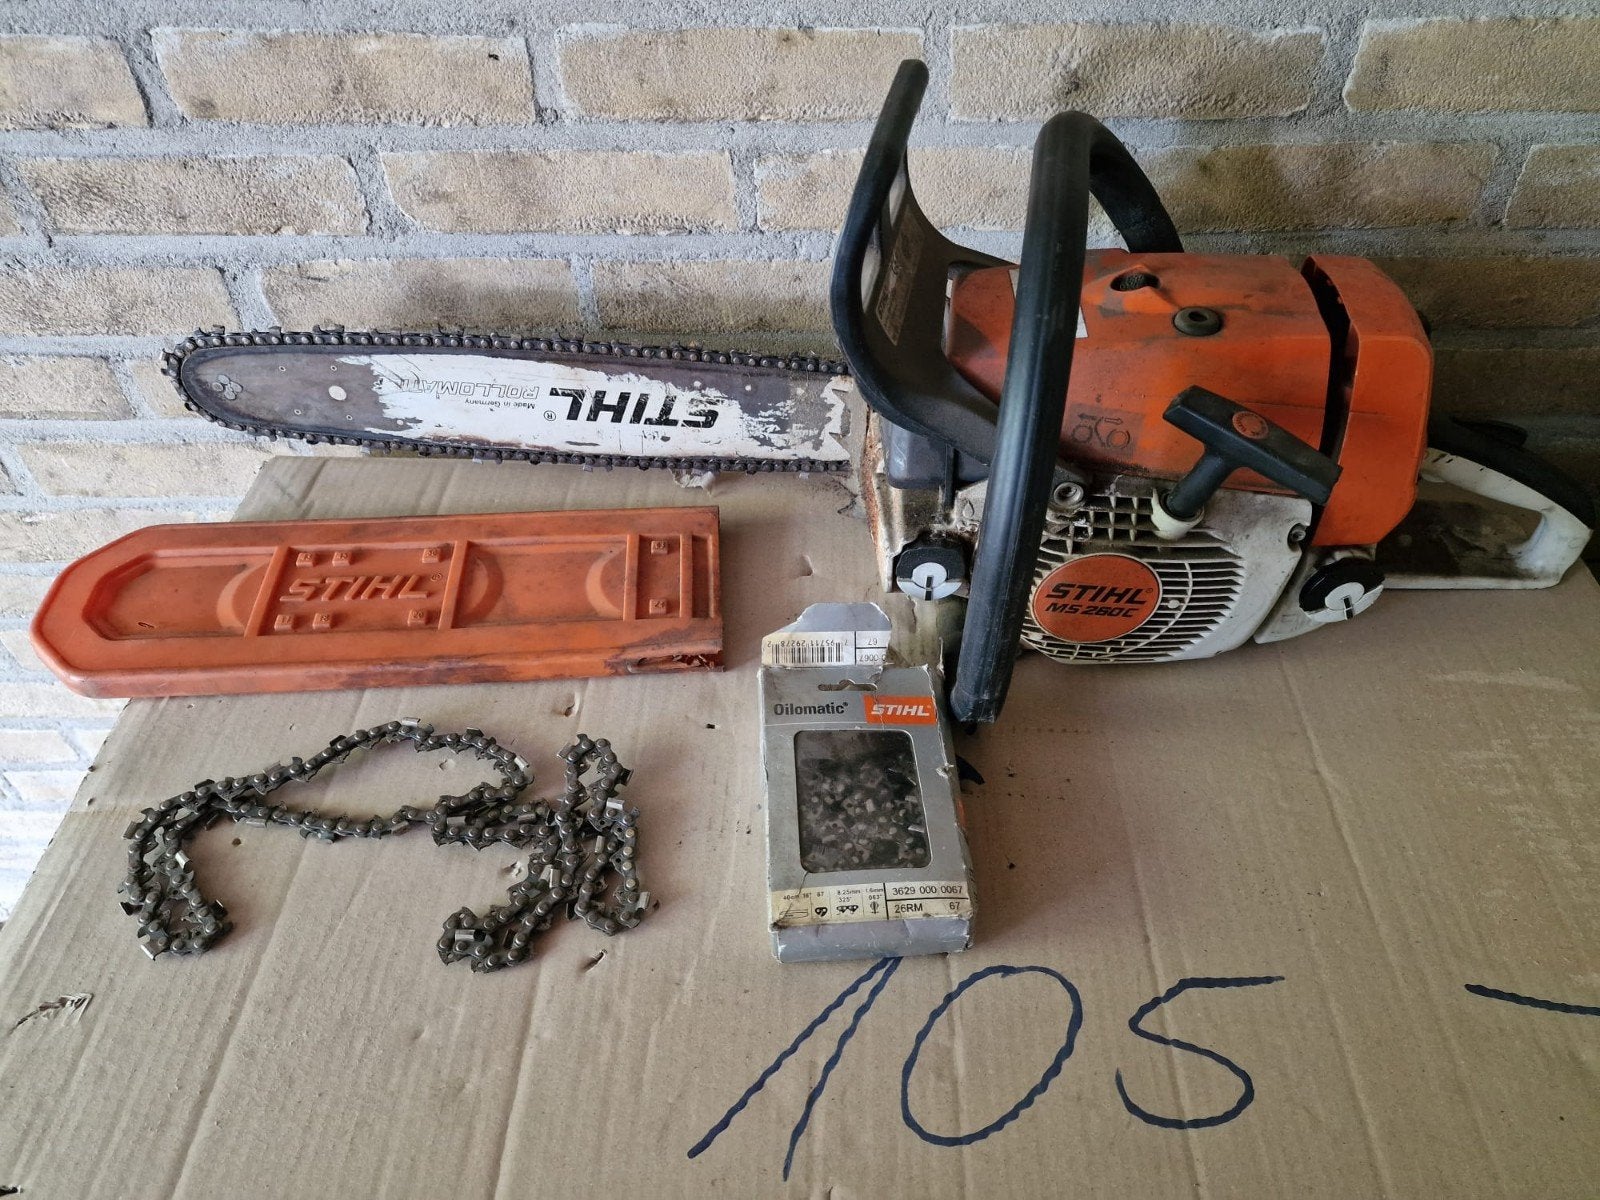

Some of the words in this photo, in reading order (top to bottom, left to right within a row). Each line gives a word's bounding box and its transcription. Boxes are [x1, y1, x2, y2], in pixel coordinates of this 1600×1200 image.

[465, 397, 501, 408] Germany
[513, 401, 535, 409] Made
[549, 387, 719, 429] STIHL
[280, 575, 429, 602] STIHL
[1046, 583, 1147, 605] STIHL
[1045, 602, 1082, 614] MS
[1081, 605, 1139, 618] 260C
[871, 704, 930, 717] STIHL
[892, 887, 916, 896] 3629
[919, 886, 937, 894] 000
[940, 886, 963, 894] 0067
[894, 903, 923, 914] 26RM
[949, 902, 960, 910] 67
[688, 957, 1284, 1181] 105
